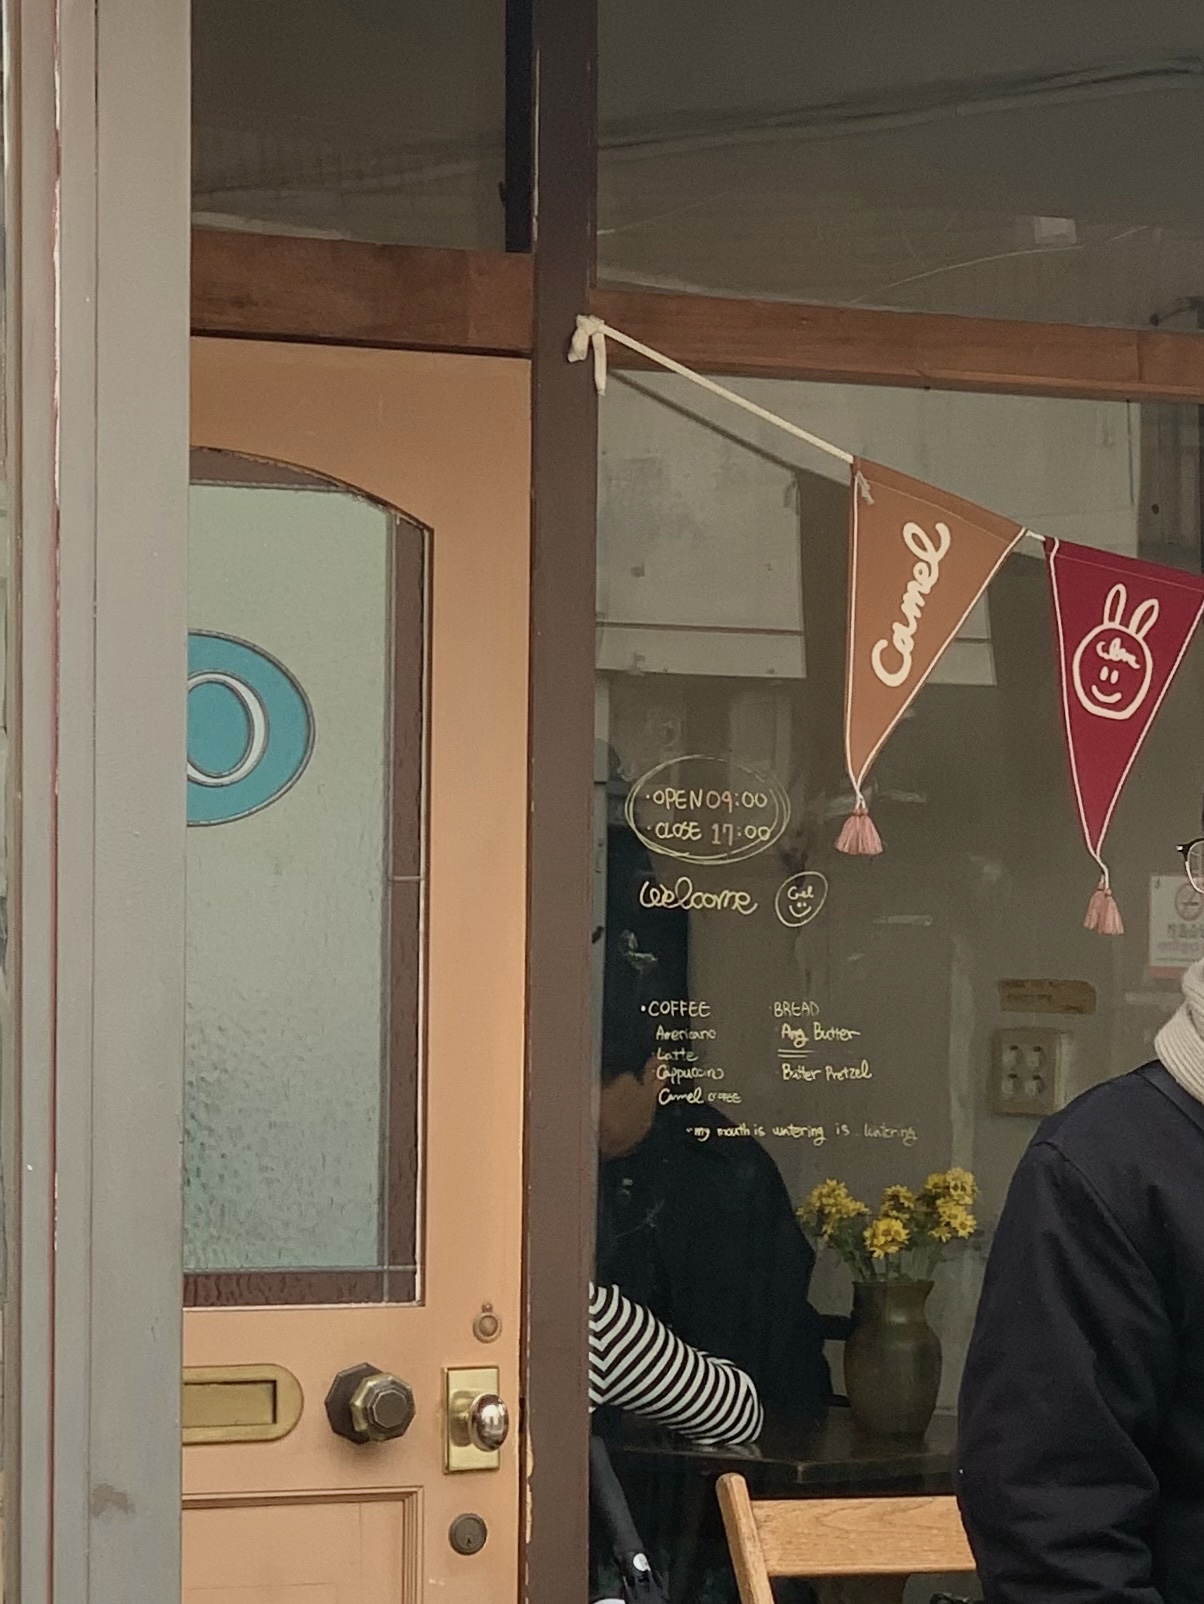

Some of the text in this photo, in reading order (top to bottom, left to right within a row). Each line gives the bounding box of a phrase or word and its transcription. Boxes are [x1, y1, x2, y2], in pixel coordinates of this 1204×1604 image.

[871, 522, 951, 687] Camel
[652, 787, 768, 814] OPEN 09:00
[655, 821, 771, 847] CLOSE 17:00
[647, 1000, 711, 1018] COFFEE
[773, 1000, 820, 1018] BREAD
[656, 1047, 699, 1062] Latte
[753, 1123, 767, 1137] is
[834, 1122, 851, 1137] is
